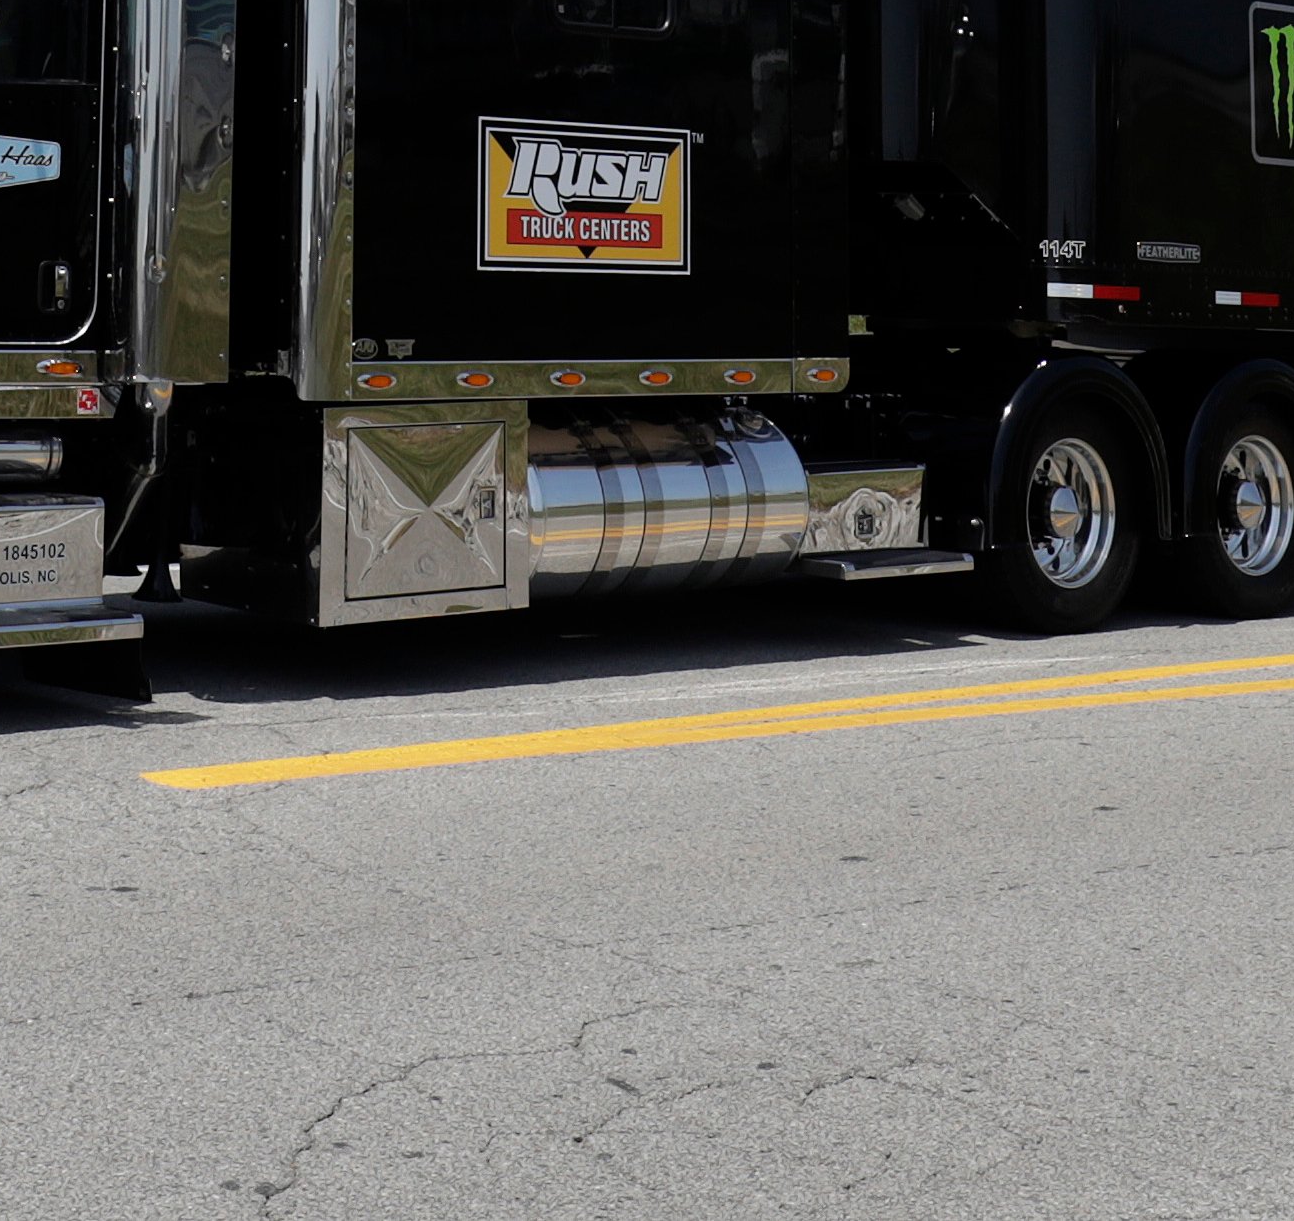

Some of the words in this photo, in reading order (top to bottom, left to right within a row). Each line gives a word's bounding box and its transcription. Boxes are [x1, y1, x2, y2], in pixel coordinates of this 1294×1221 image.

[691, 132, 704, 144] TM
[1, 146, 54, 166] Haas
[502, 136, 669, 217] RUSH
[521, 216, 574, 239] TRUCK
[579, 218, 651, 242] CENTERS
[1039, 240, 1086, 259] 114T
[1140, 245, 1199, 260] FEATHERLITE
[3, 543, 66, 560] 1845102
[38, 569, 56, 582] NC
